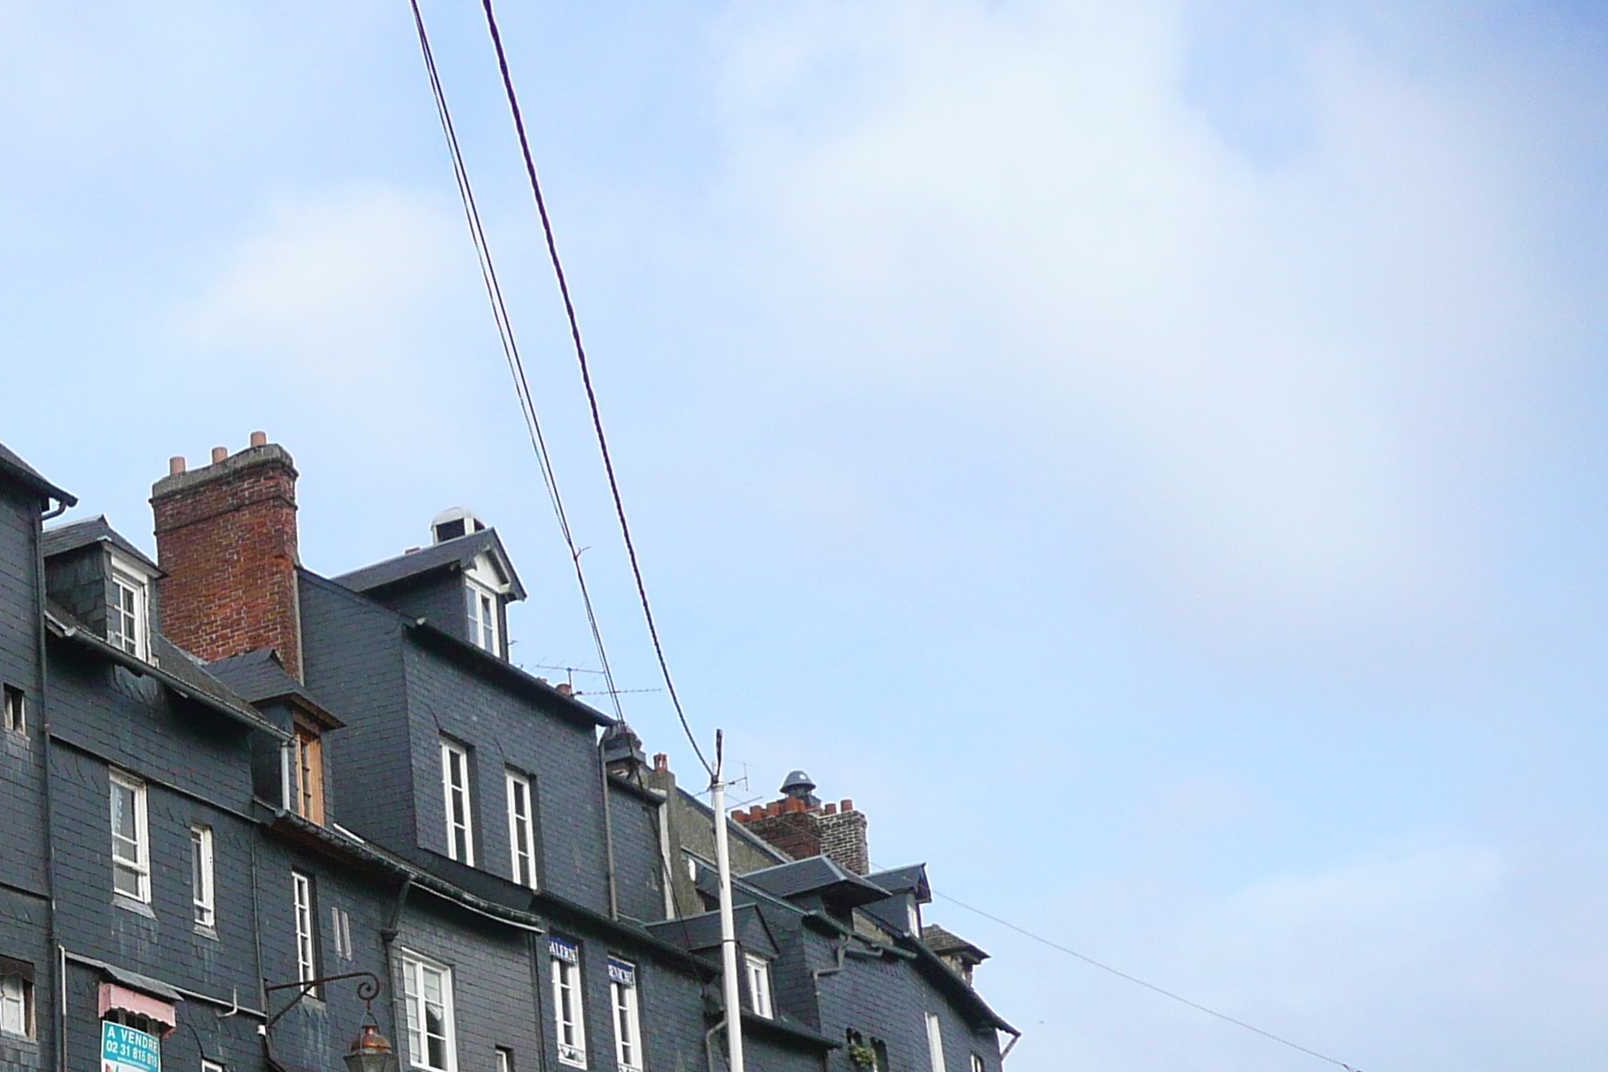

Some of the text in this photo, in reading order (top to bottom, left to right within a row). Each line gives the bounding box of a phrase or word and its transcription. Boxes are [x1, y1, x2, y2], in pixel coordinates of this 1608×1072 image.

[106, 1040, 118, 1054] 02
[120, 1044, 131, 1058] 31
[132, 1047, 147, 1062] 815
[107, 1026, 158, 1054] A VENDRE
